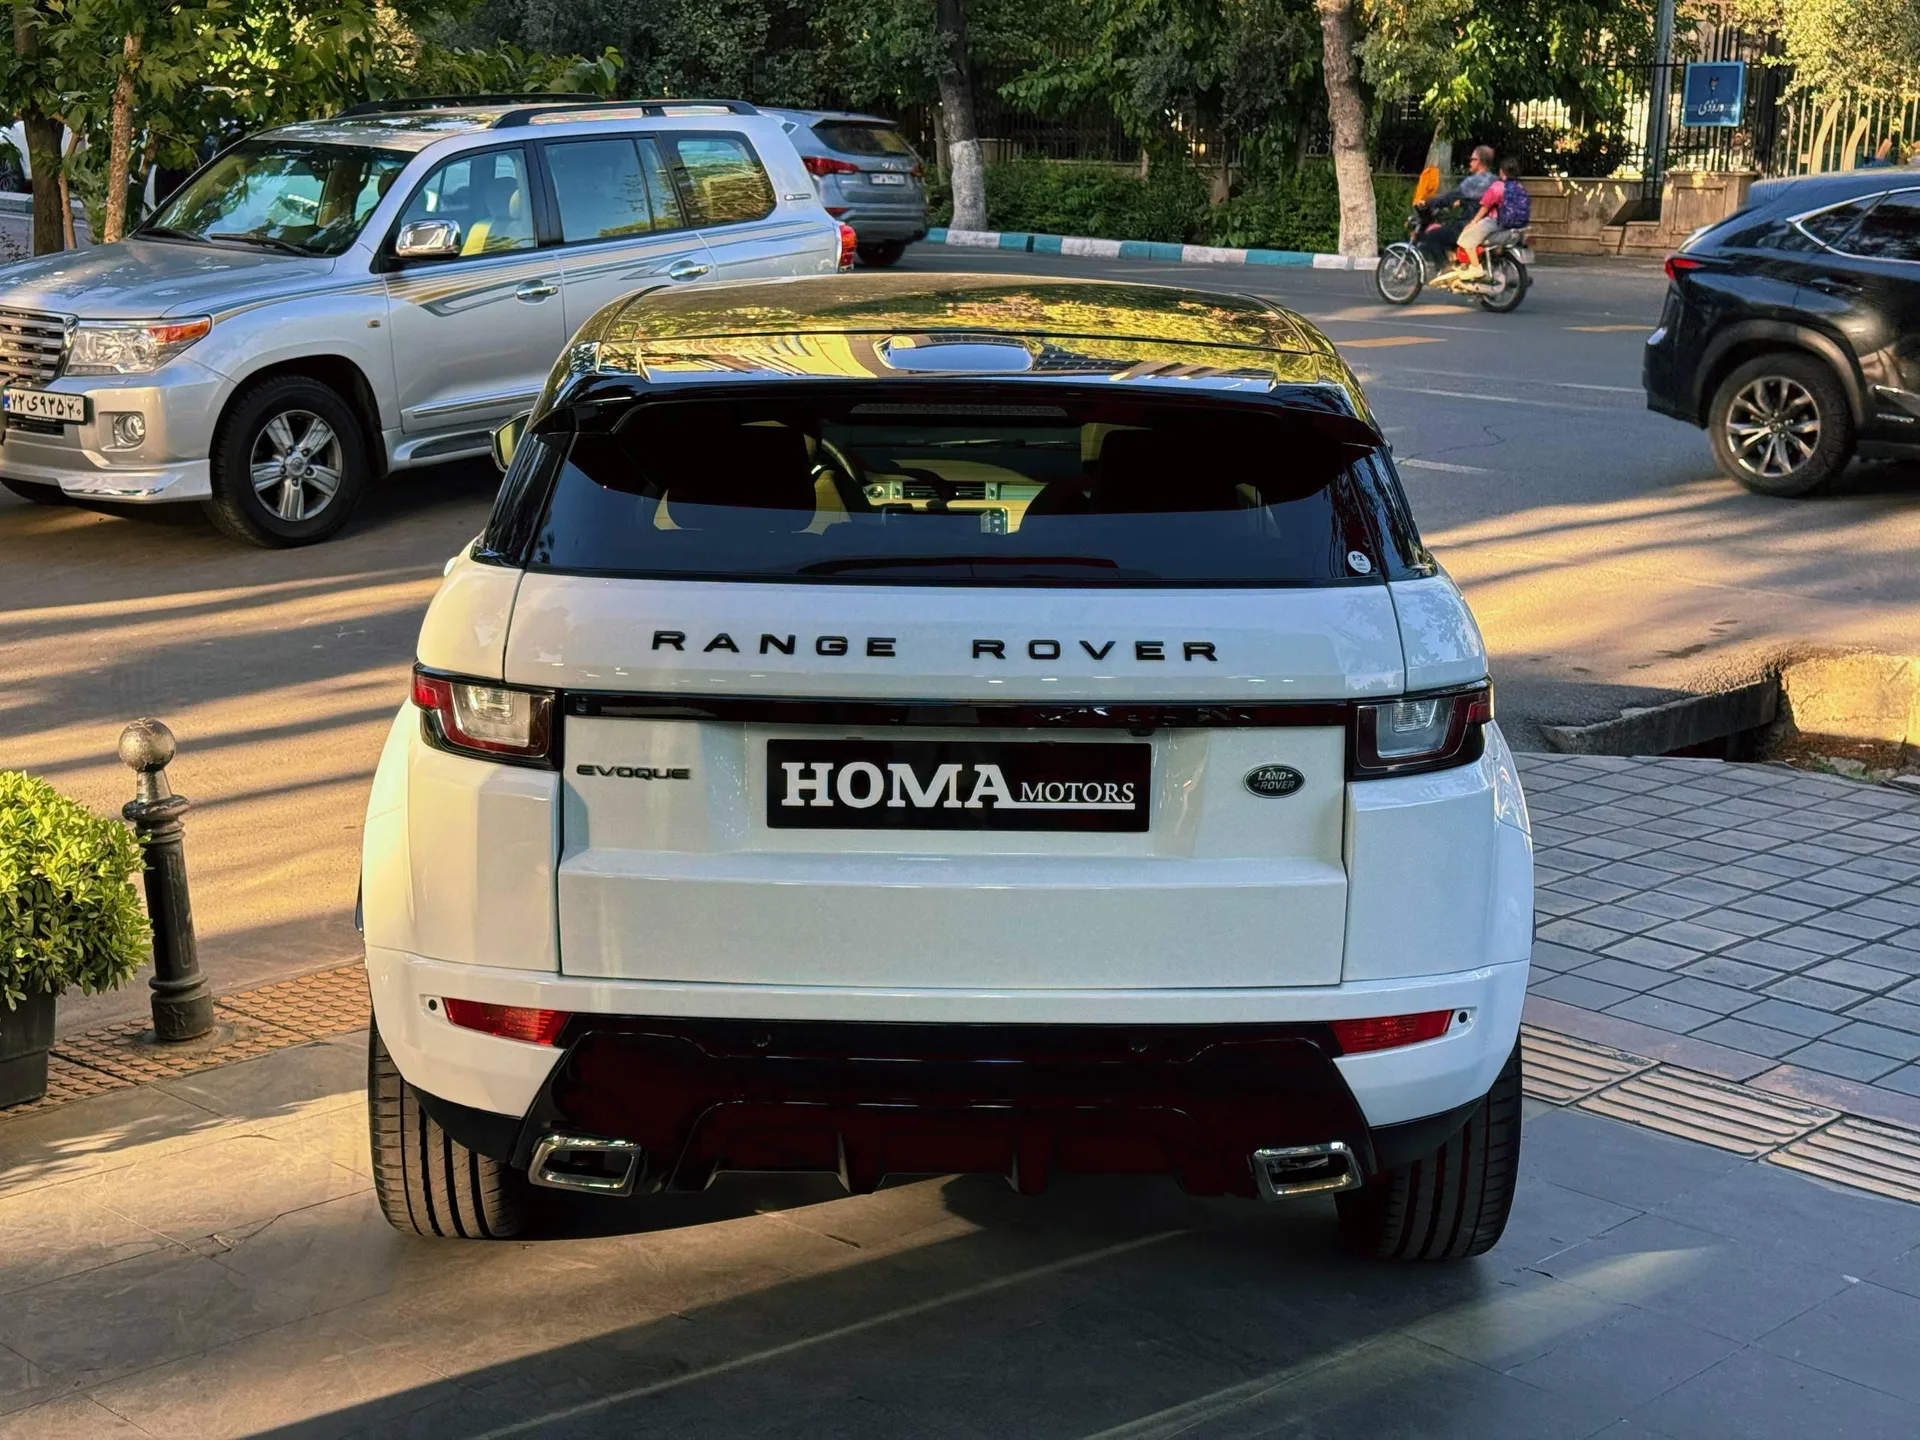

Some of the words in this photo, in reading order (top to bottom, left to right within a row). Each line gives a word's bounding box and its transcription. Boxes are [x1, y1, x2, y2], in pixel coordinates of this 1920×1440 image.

[651, 630, 897, 657] RANGE
[972, 639, 1219, 662] ROVER
[576, 764, 691, 780] EVOQUE
[1258, 771, 1287, 780] LAND
[780, 762, 1019, 810] HOMA
[1019, 781, 1135, 804] MOTORS
[1260, 780, 1295, 789] ROVER
